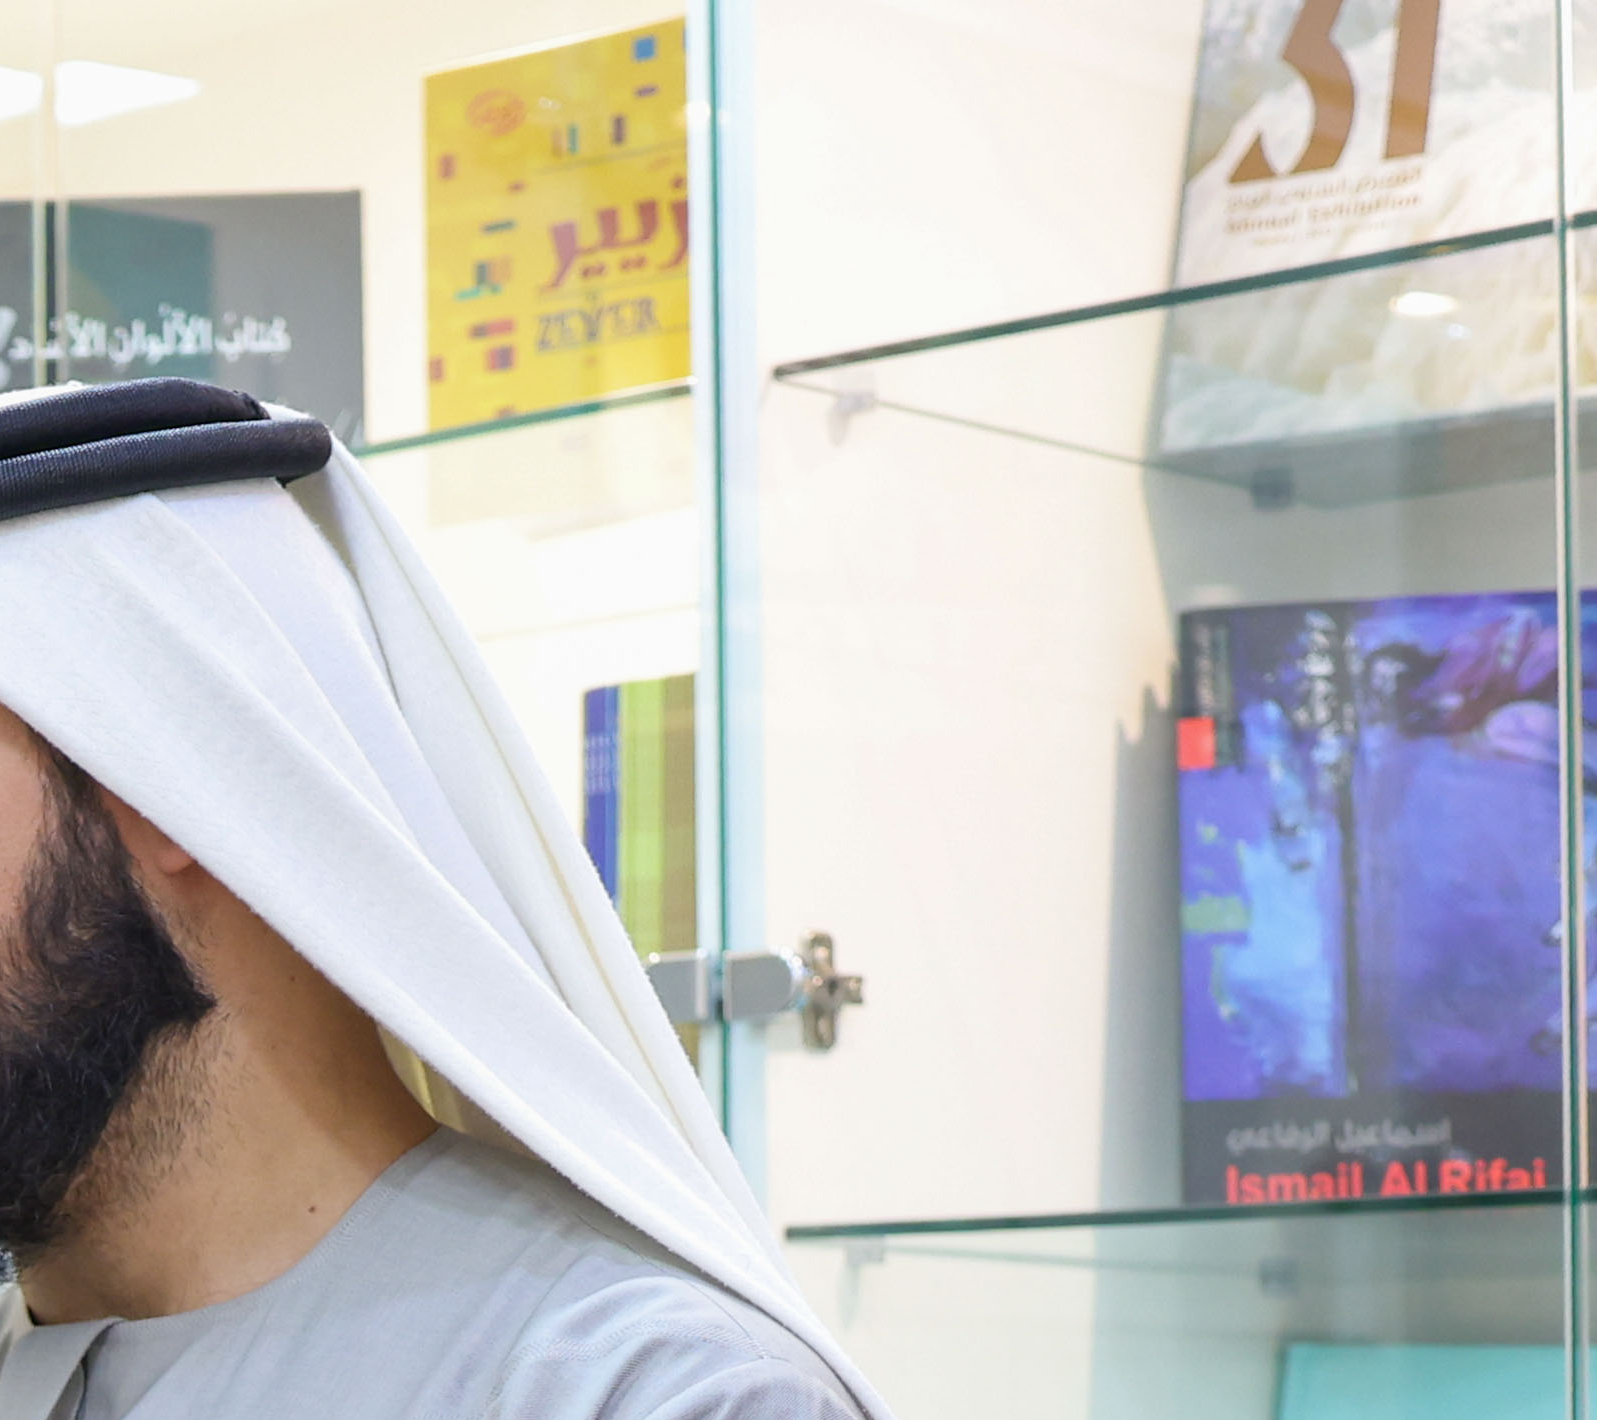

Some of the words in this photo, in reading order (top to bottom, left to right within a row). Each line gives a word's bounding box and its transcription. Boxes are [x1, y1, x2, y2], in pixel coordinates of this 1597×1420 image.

[1226, 1161, 1364, 1204] Ismail
[1380, 1160, 1428, 1197] Al
[1439, 1157, 1546, 1193] Rifai
